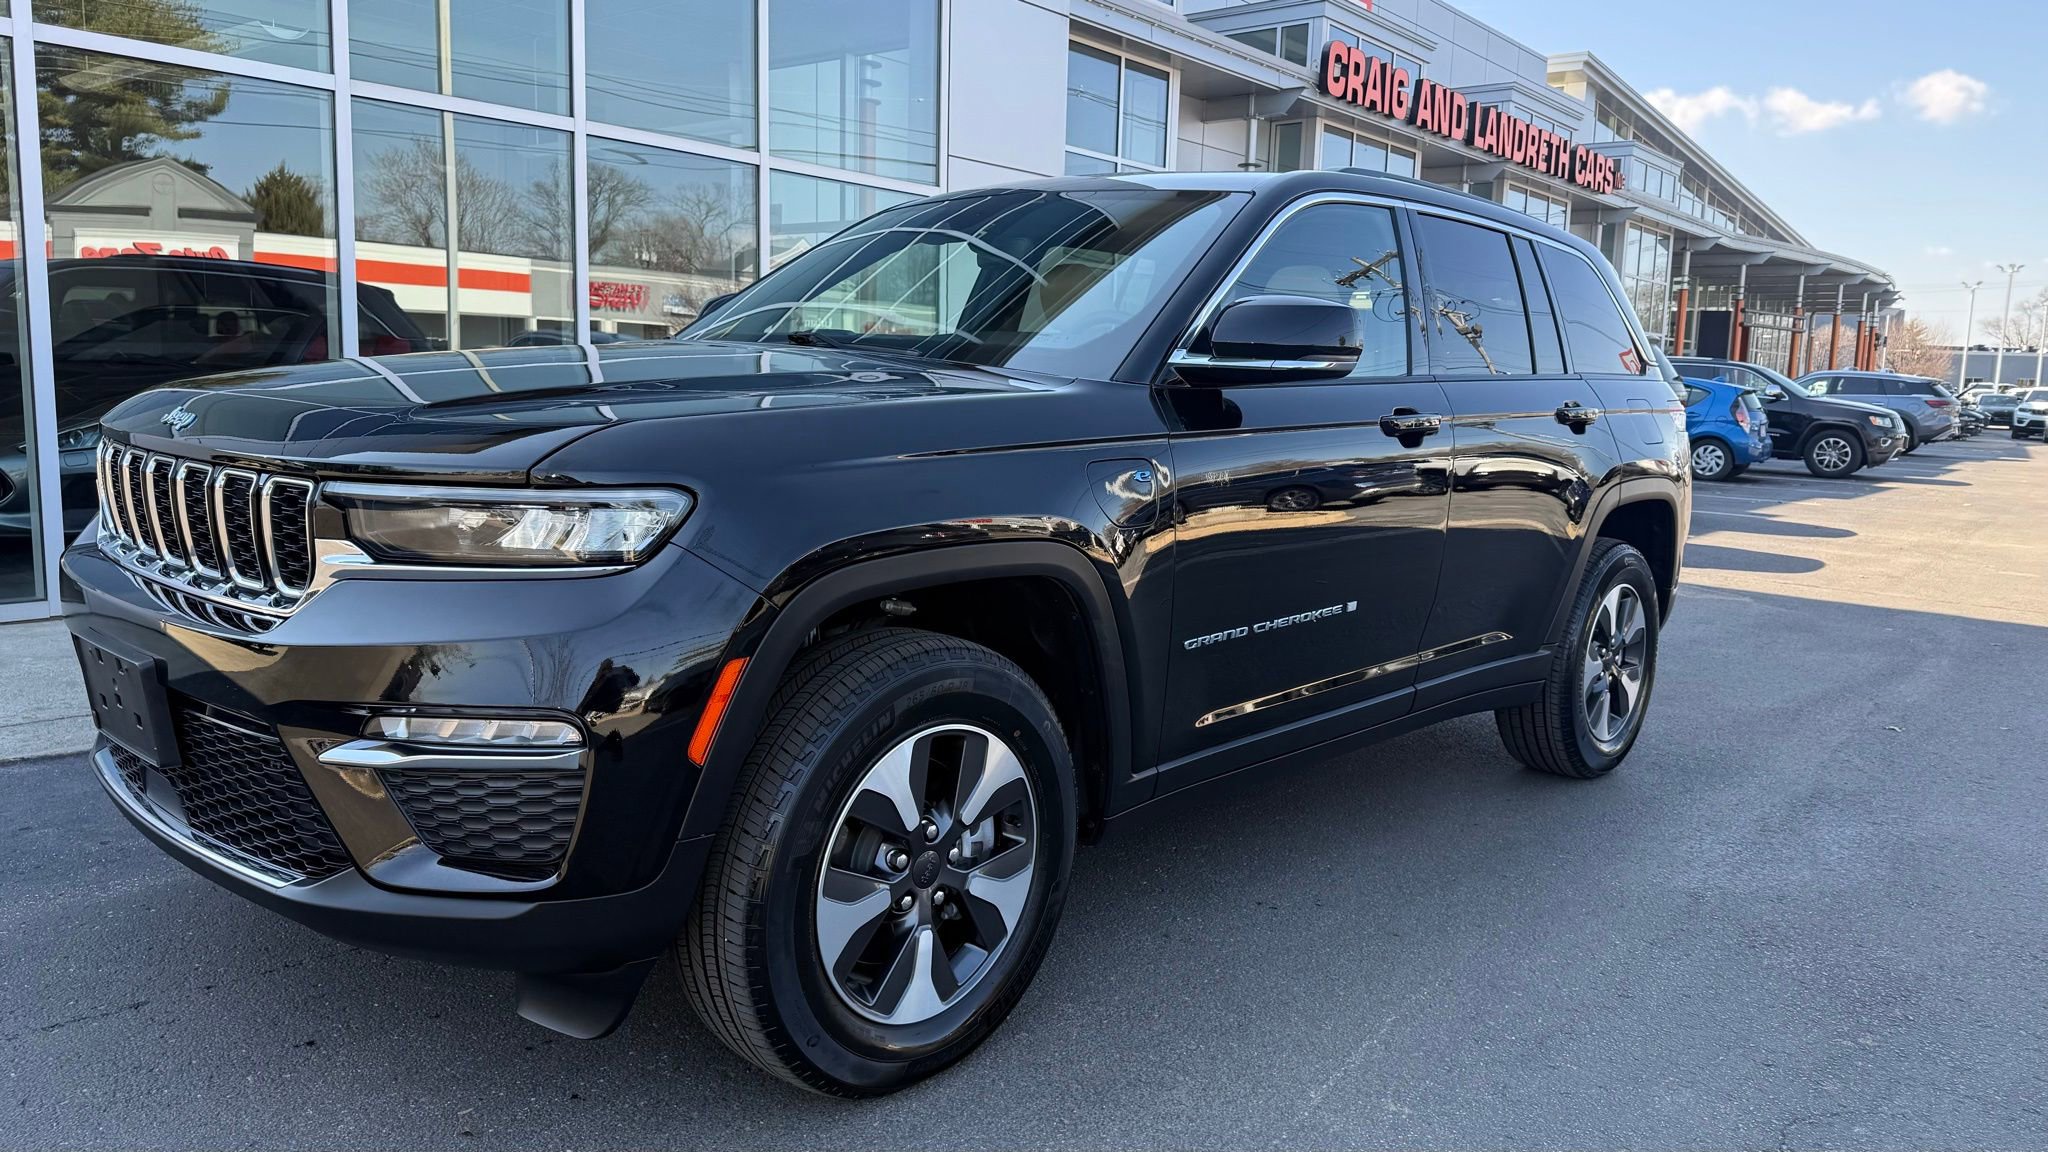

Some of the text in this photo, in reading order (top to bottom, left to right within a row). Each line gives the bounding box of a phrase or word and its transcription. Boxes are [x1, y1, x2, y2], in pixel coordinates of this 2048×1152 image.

[1321, 40, 1409, 120] CRAIG
[1412, 78, 1467, 141] AND
[1469, 101, 1571, 180] LANDRETH
[1573, 144, 1614, 195] CARS
[160, 406, 197, 431] Jeep
[1183, 603, 1343, 650] GRAND CHEROKEE
[813, 709, 893, 813] MICHELIN
